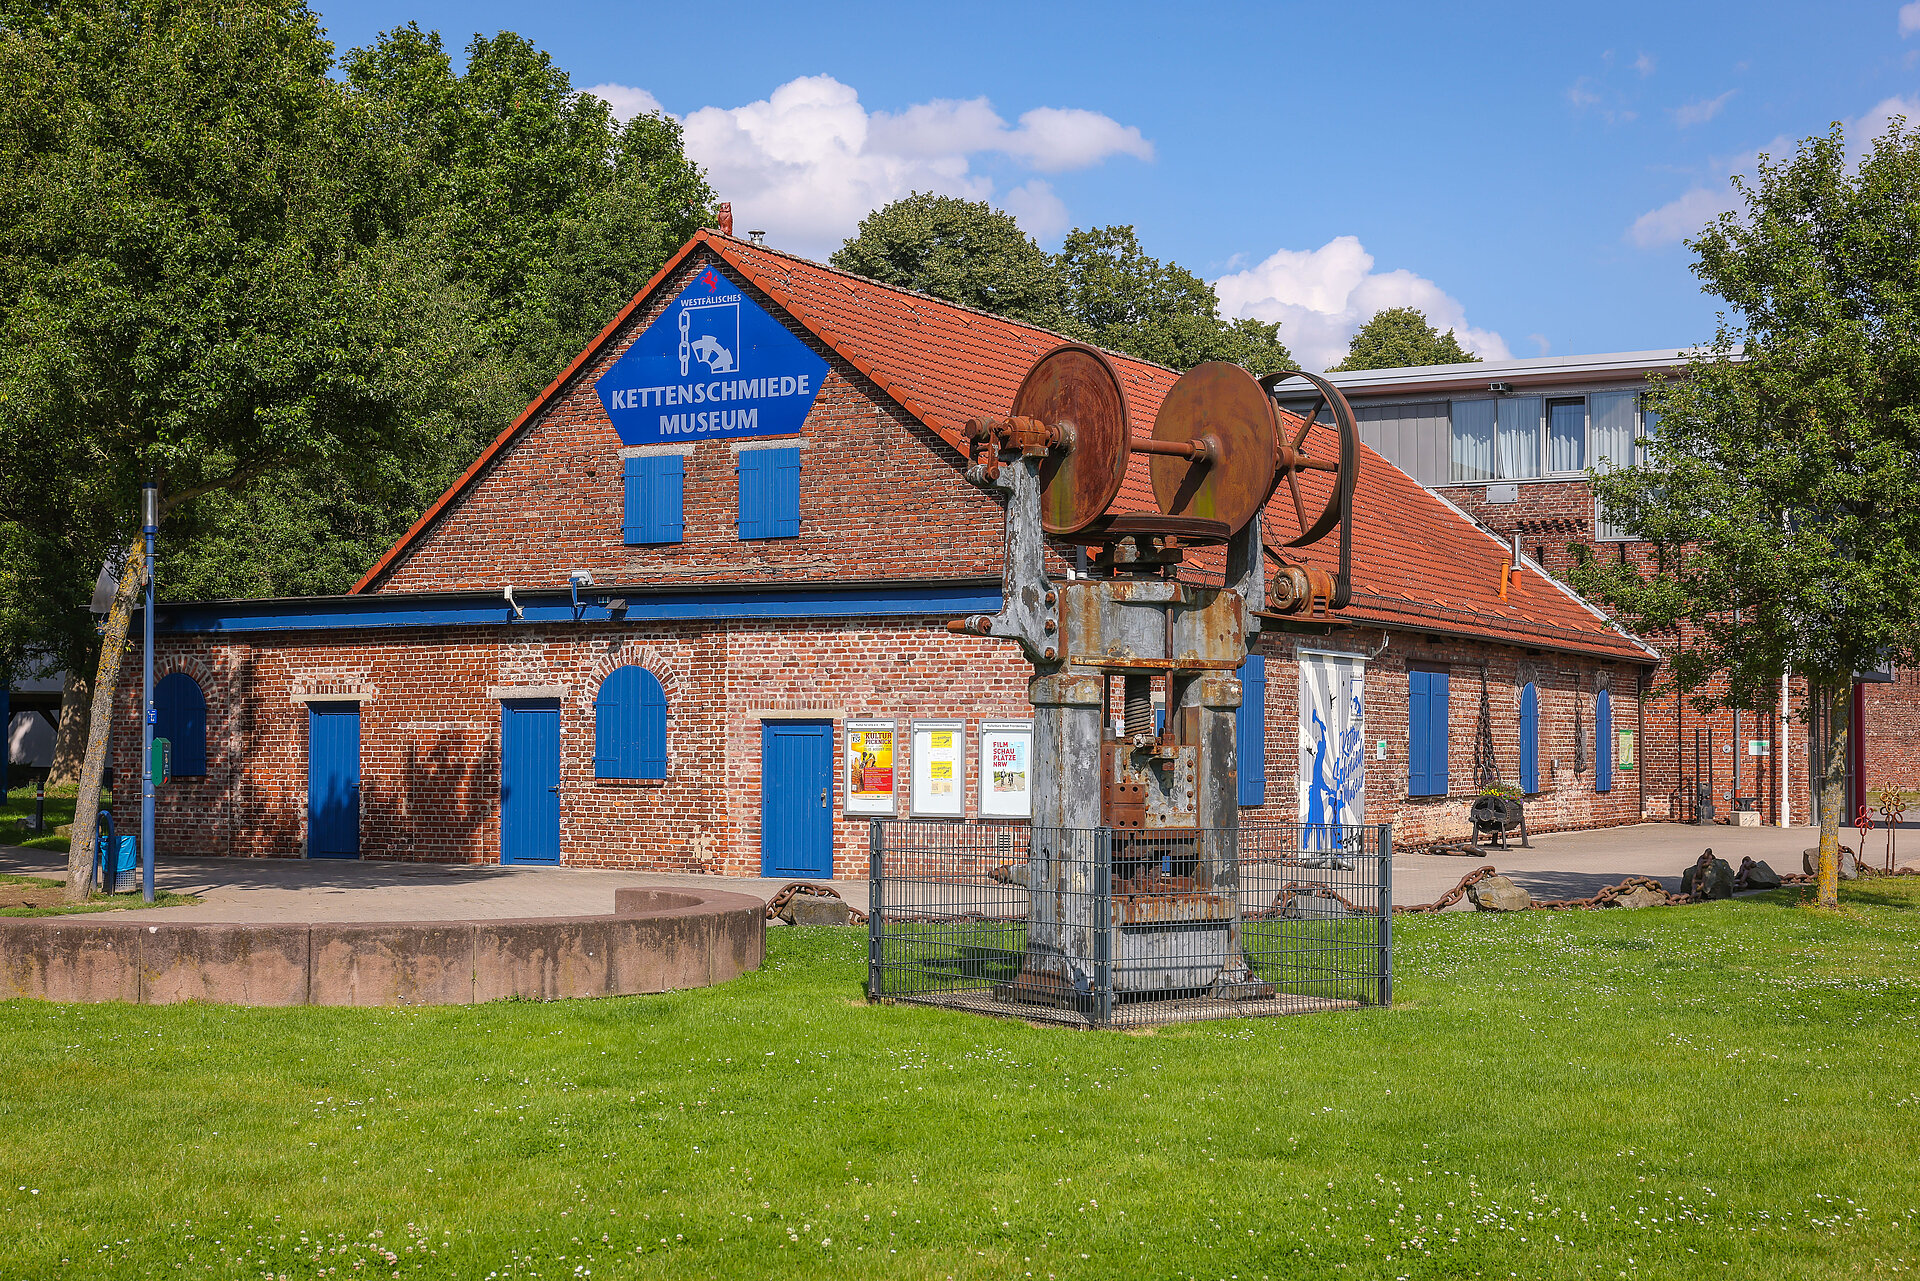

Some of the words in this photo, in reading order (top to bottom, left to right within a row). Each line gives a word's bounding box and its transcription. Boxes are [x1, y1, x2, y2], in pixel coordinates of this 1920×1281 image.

[680, 293, 742, 307] WESTFÄLISCHES
[611, 374, 810, 410] KETTENSCHMIEDE
[659, 408, 758, 435] MUSEUM
